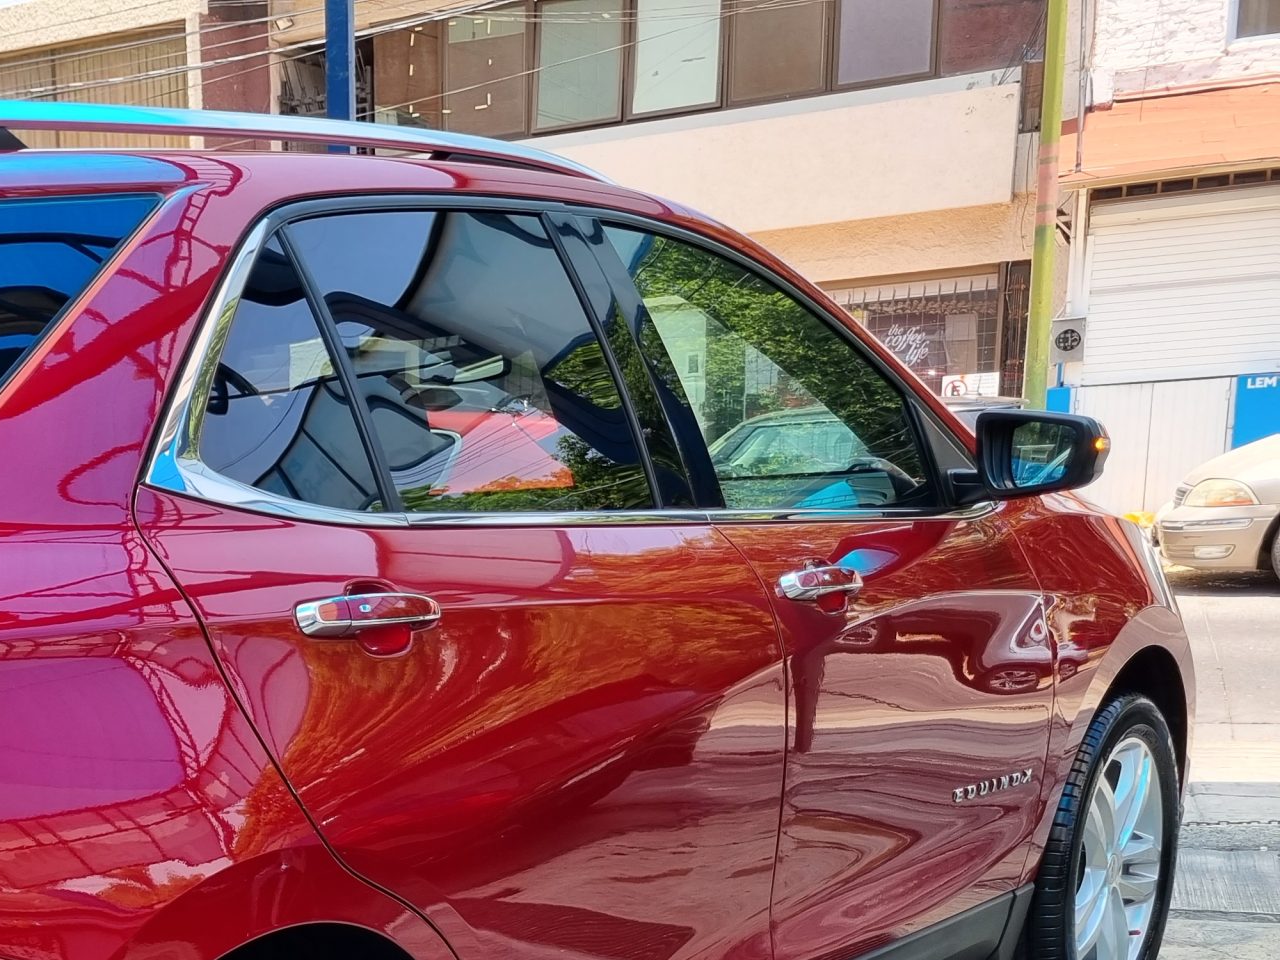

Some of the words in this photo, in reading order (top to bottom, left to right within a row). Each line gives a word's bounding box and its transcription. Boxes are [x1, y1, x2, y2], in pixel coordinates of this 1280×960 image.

[884, 327, 926, 353] coffee
[888, 323, 904, 336] the
[905, 340, 931, 367] life
